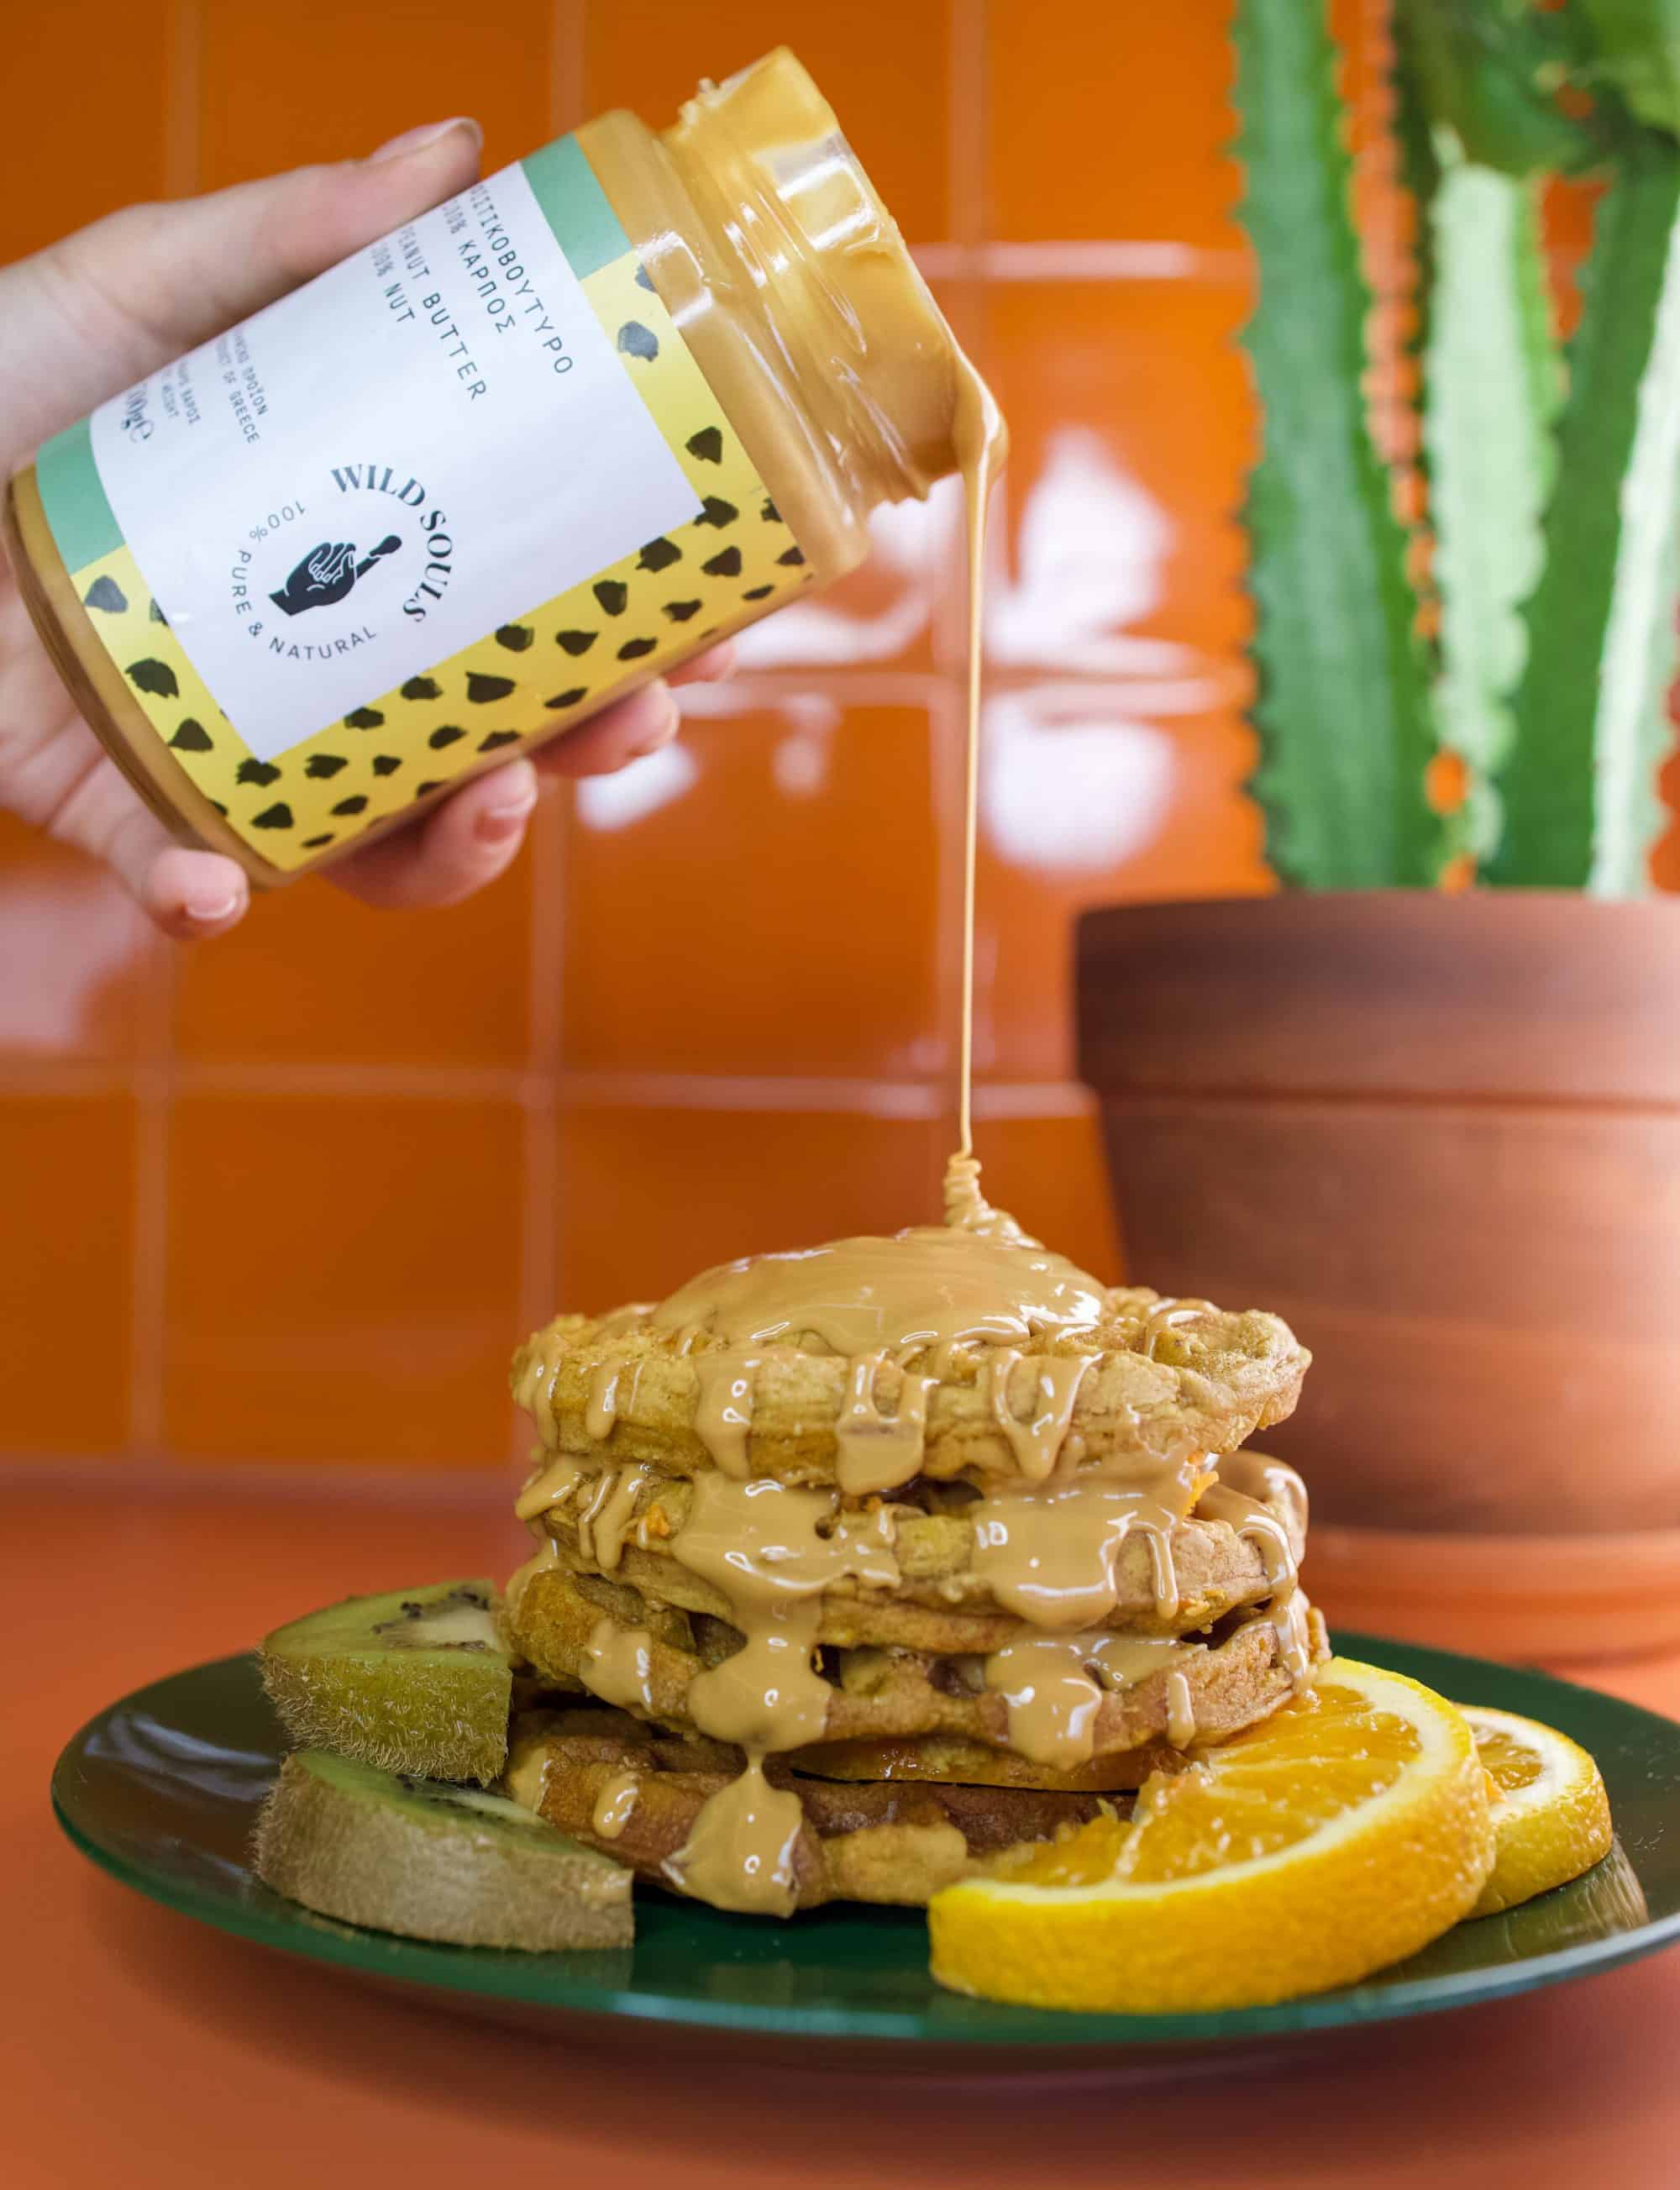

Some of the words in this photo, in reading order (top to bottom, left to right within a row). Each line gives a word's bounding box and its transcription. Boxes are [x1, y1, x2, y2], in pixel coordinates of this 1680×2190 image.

[383, 282, 416, 323] NUT
[458, 239, 517, 333] ΚΑΡΠΟΣ
[423, 292, 486, 401] BUTTER
[228, 390, 260, 444] GREECE
[249, 501, 306, 543] 100%
[330, 464, 425, 507] WILD
[402, 510, 453, 622] SOULS
[231, 549, 252, 615] PURE
[248, 622, 263, 637] &
[269, 626, 377, 660] NATURAL
